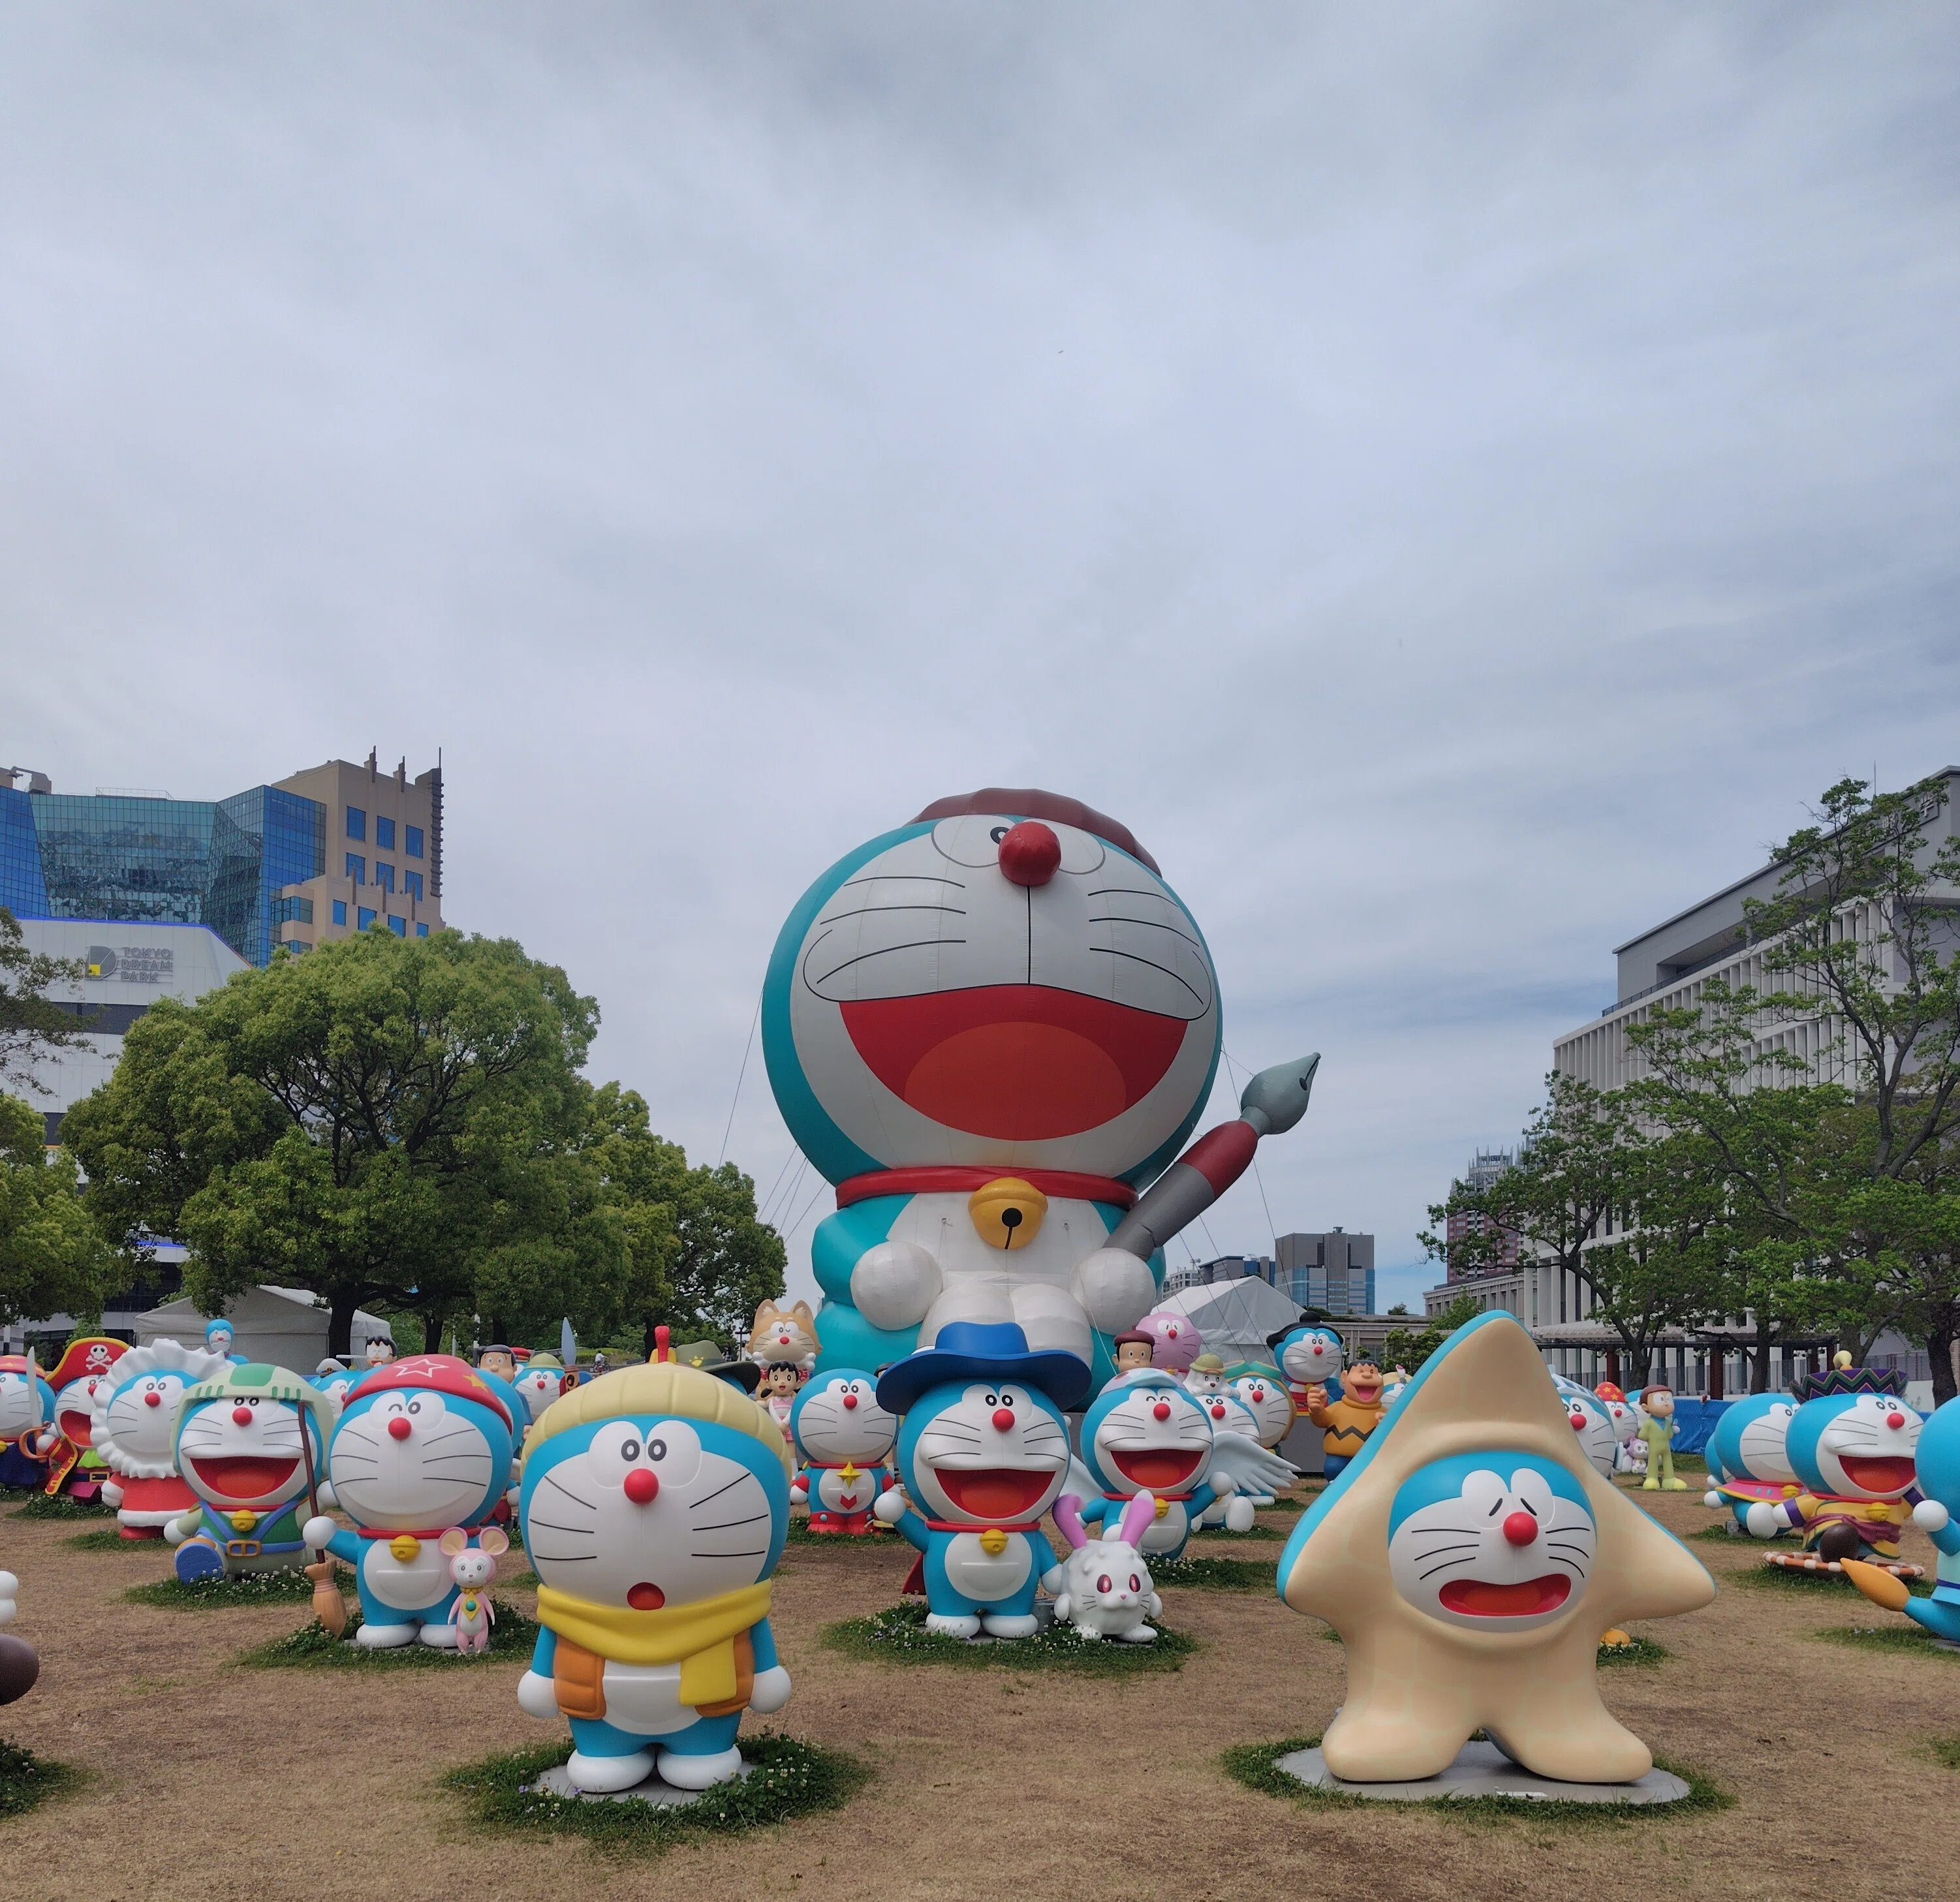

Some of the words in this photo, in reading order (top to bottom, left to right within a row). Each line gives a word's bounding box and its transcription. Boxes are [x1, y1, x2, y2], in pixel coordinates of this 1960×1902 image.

[121, 947, 171, 959] TOKYO
[121, 959, 171, 971] DREAM
[121, 971, 159, 982] PARK
